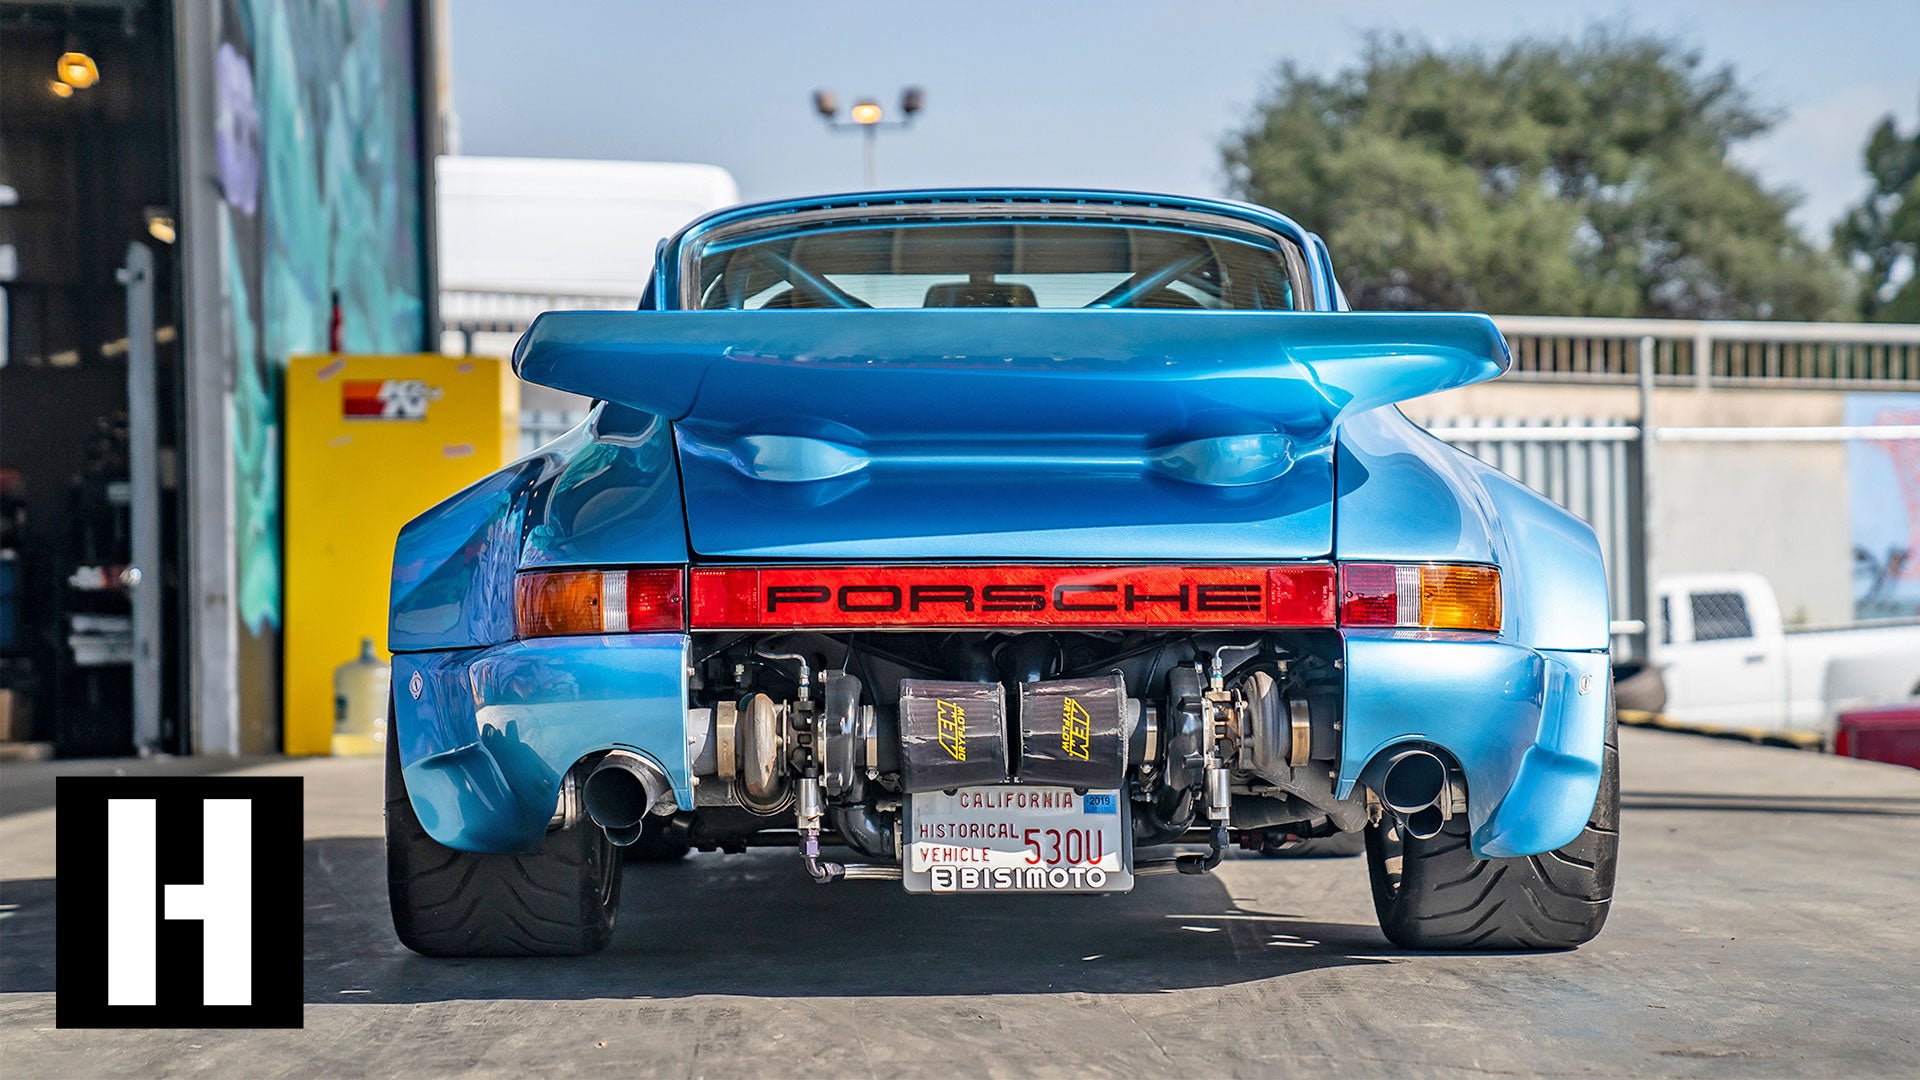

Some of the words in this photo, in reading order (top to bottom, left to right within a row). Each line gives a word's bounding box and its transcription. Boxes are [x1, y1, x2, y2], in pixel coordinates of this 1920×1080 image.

[376, 380, 430, 417] KN
[766, 585, 1261, 612] PORSCHE
[957, 706, 966, 762] DRYFLOW
[1062, 696, 1072, 753] DRYFLOW
[961, 793, 1073, 808] CALIFORNIA
[1089, 796, 1110, 806] 2019
[919, 823, 1019, 838] HISTORICAL
[920, 847, 991, 862] VEHICLE
[1024, 828, 1103, 865] 530U
[961, 867, 1107, 889] BISIMOTO
